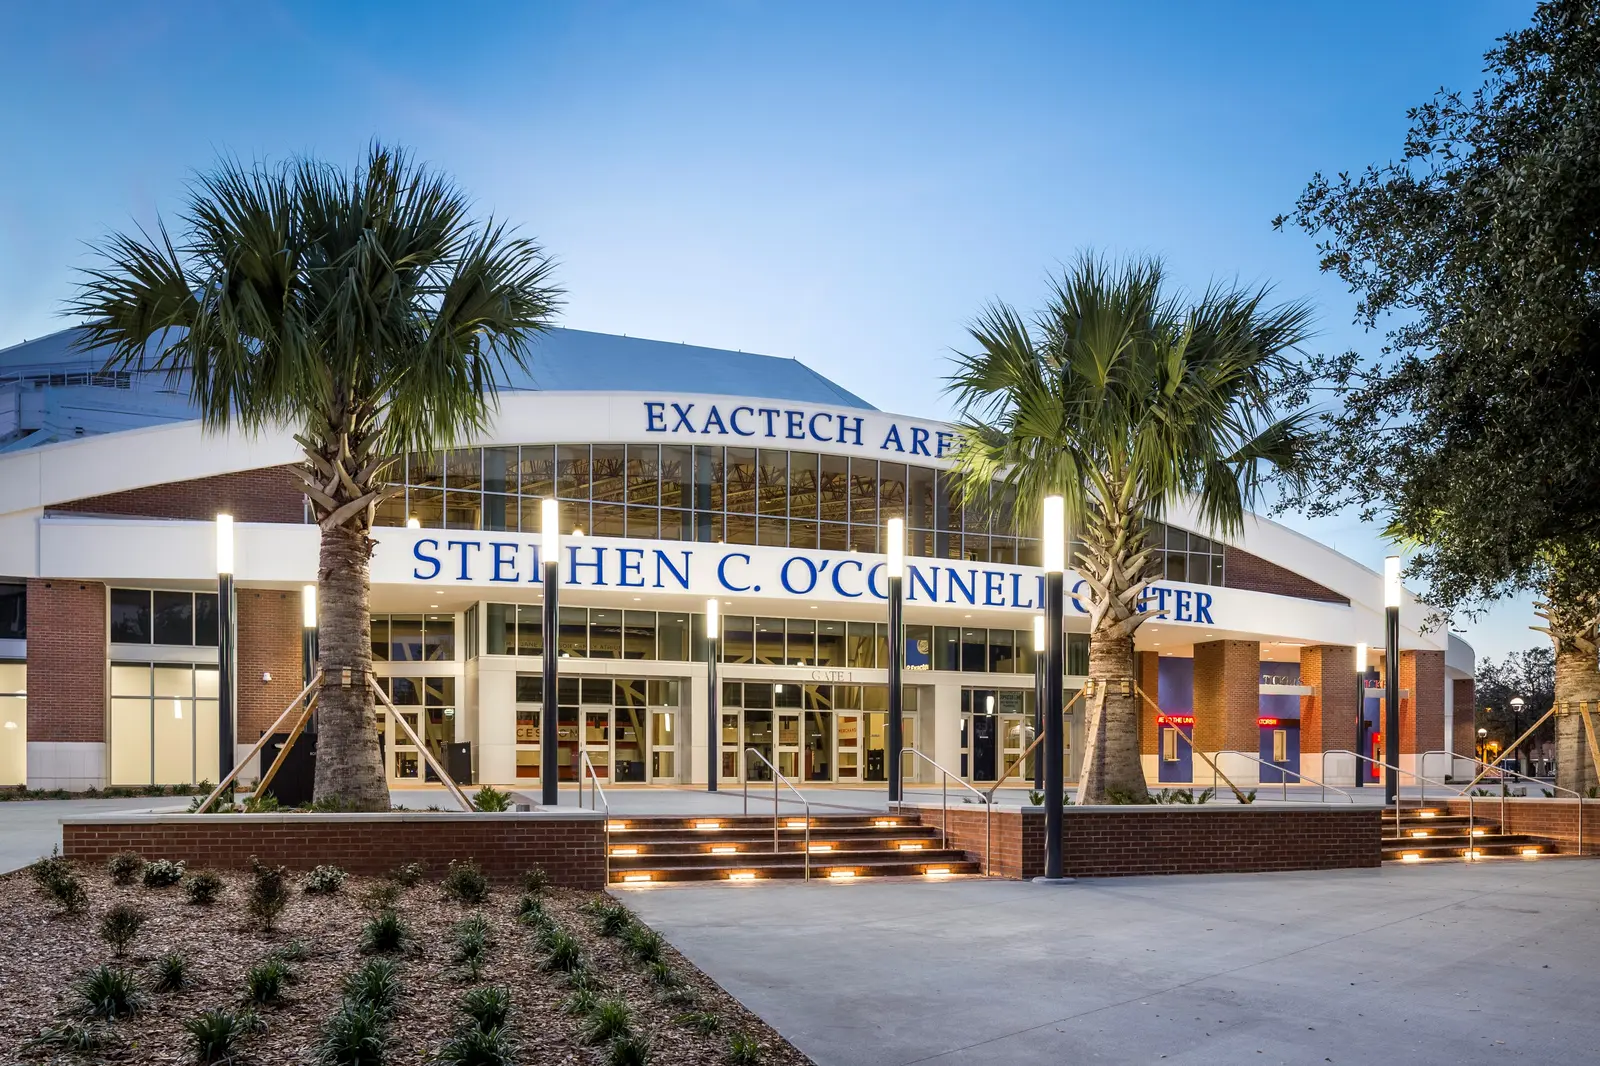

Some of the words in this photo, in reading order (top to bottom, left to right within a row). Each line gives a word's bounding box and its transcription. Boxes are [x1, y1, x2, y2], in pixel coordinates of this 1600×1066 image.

[644, 402, 865, 446] EXACTECH
[881, 424, 970, 463] ARE
[717, 553, 761, 593] C.
[1072, 579, 1215, 625] CTER
[811, 669, 844, 681] GATE
[847, 671, 853, 682] 1
